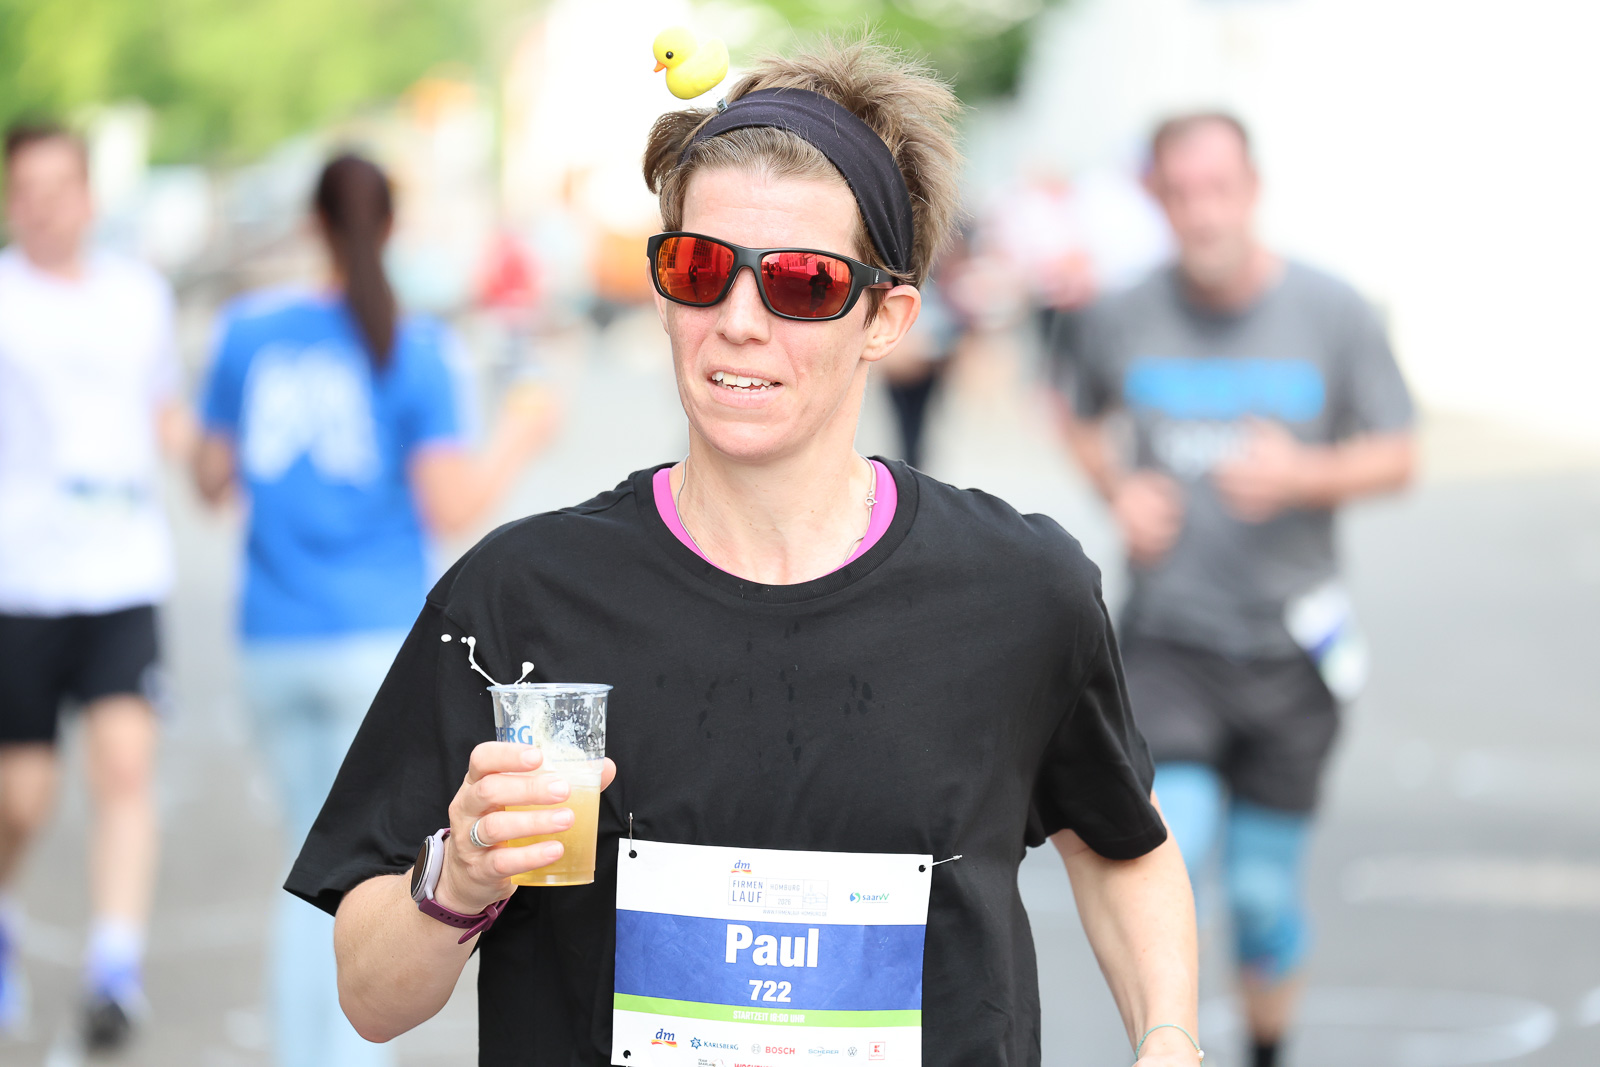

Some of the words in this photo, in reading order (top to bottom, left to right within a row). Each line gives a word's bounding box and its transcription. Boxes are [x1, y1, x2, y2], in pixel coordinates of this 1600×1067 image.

[734, 860, 751, 870] dm
[732, 879, 764, 890] FIRMEN
[769, 883, 801, 892] HOMBURG
[732, 890, 763, 903] LAUF
[725, 923, 820, 968] Paul
[748, 979, 792, 1003] 722
[733, 1010, 769, 1021] STARTZEIT
[790, 1014, 806, 1024] UHR
[655, 1028, 676, 1041] dm
[703, 1041, 739, 1051] KARLSBERG
[765, 1046, 796, 1055] BOSCH
